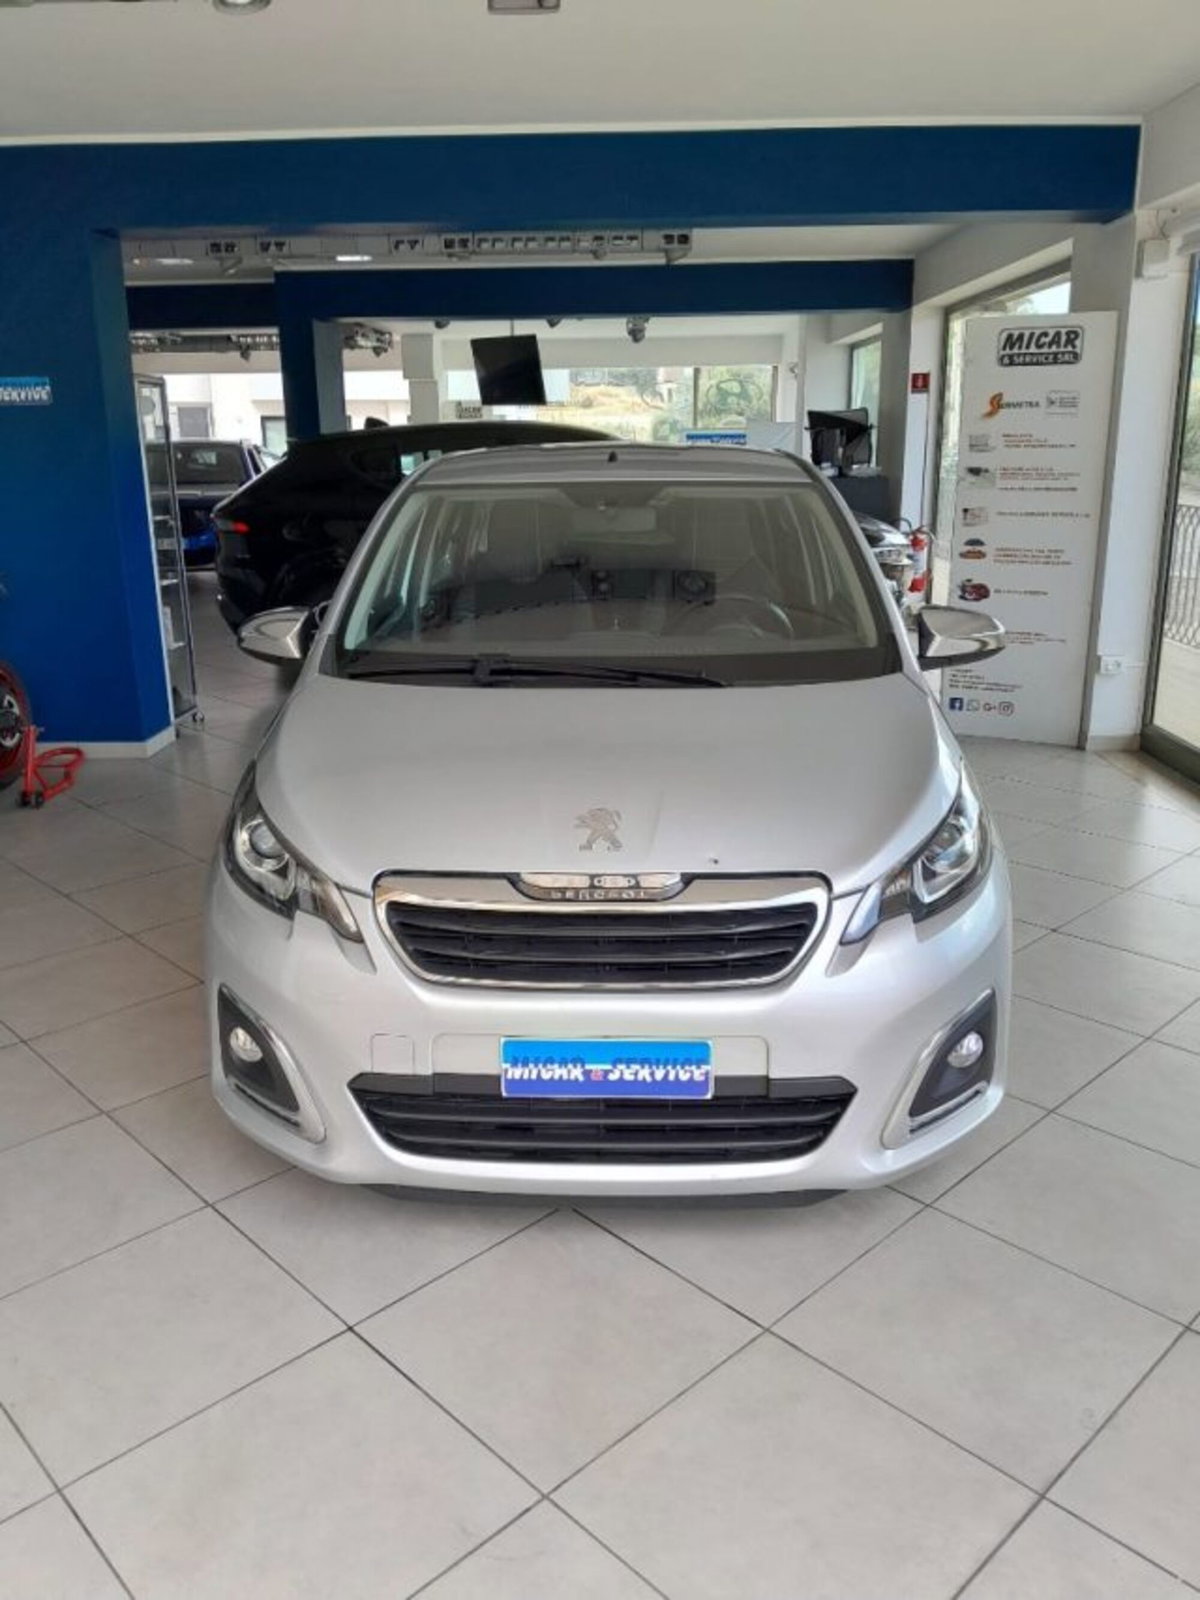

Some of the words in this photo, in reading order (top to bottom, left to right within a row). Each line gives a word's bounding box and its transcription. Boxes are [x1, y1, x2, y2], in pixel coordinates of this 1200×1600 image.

[1001, 329, 1081, 352] MICAR
[1012, 352, 1054, 364] SERVICE
[1057, 351, 1077, 363] SRL
[0, 381, 49, 401] ERVICE
[505, 1056, 585, 1082] MICAR
[607, 1057, 707, 1082] SERVICE
